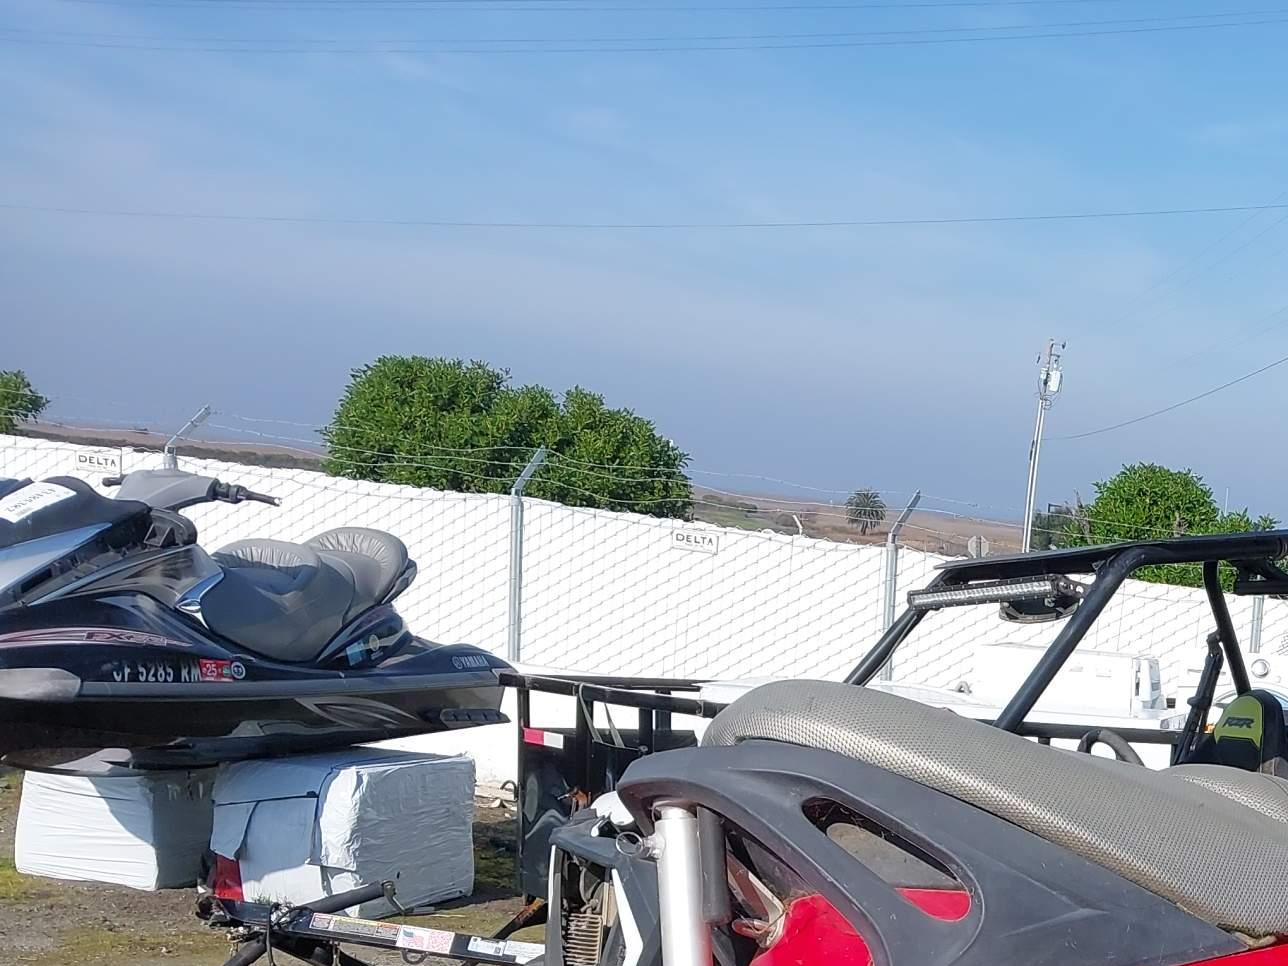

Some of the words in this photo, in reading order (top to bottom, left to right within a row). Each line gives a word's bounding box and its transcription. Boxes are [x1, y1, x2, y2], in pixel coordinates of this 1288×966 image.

[78, 454, 117, 467] DELTA
[675, 532, 714, 546] DELTA
[460, 655, 490, 669] YAMAHA
[138, 661, 174, 683] 5285
[206, 663, 217, 676] 25
[1221, 716, 1255, 729] RZR
